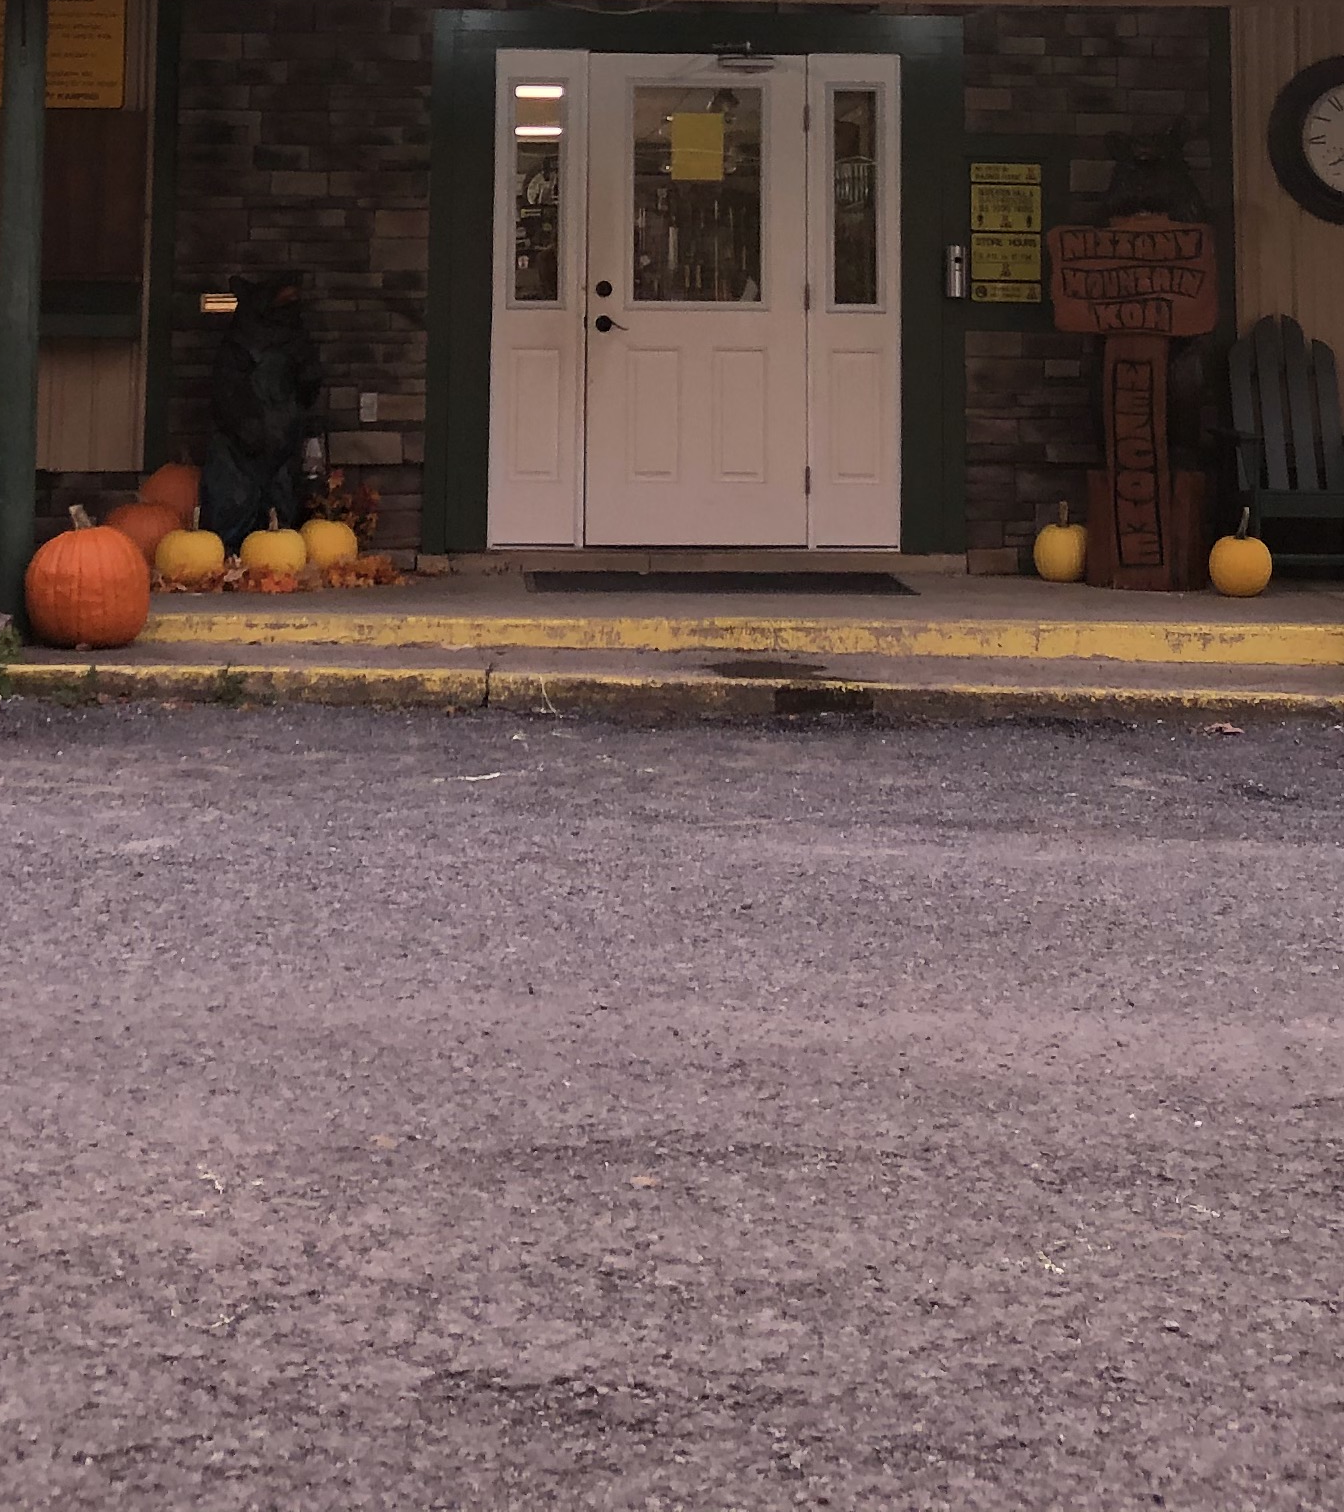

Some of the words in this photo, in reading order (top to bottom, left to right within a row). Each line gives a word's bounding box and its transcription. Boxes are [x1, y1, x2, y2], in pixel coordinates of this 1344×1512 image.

[1061, 230, 1201, 261] NITTANY
[1063, 266, 1204, 299] MOUNTAIN
[1095, 299, 1172, 331] KOA
